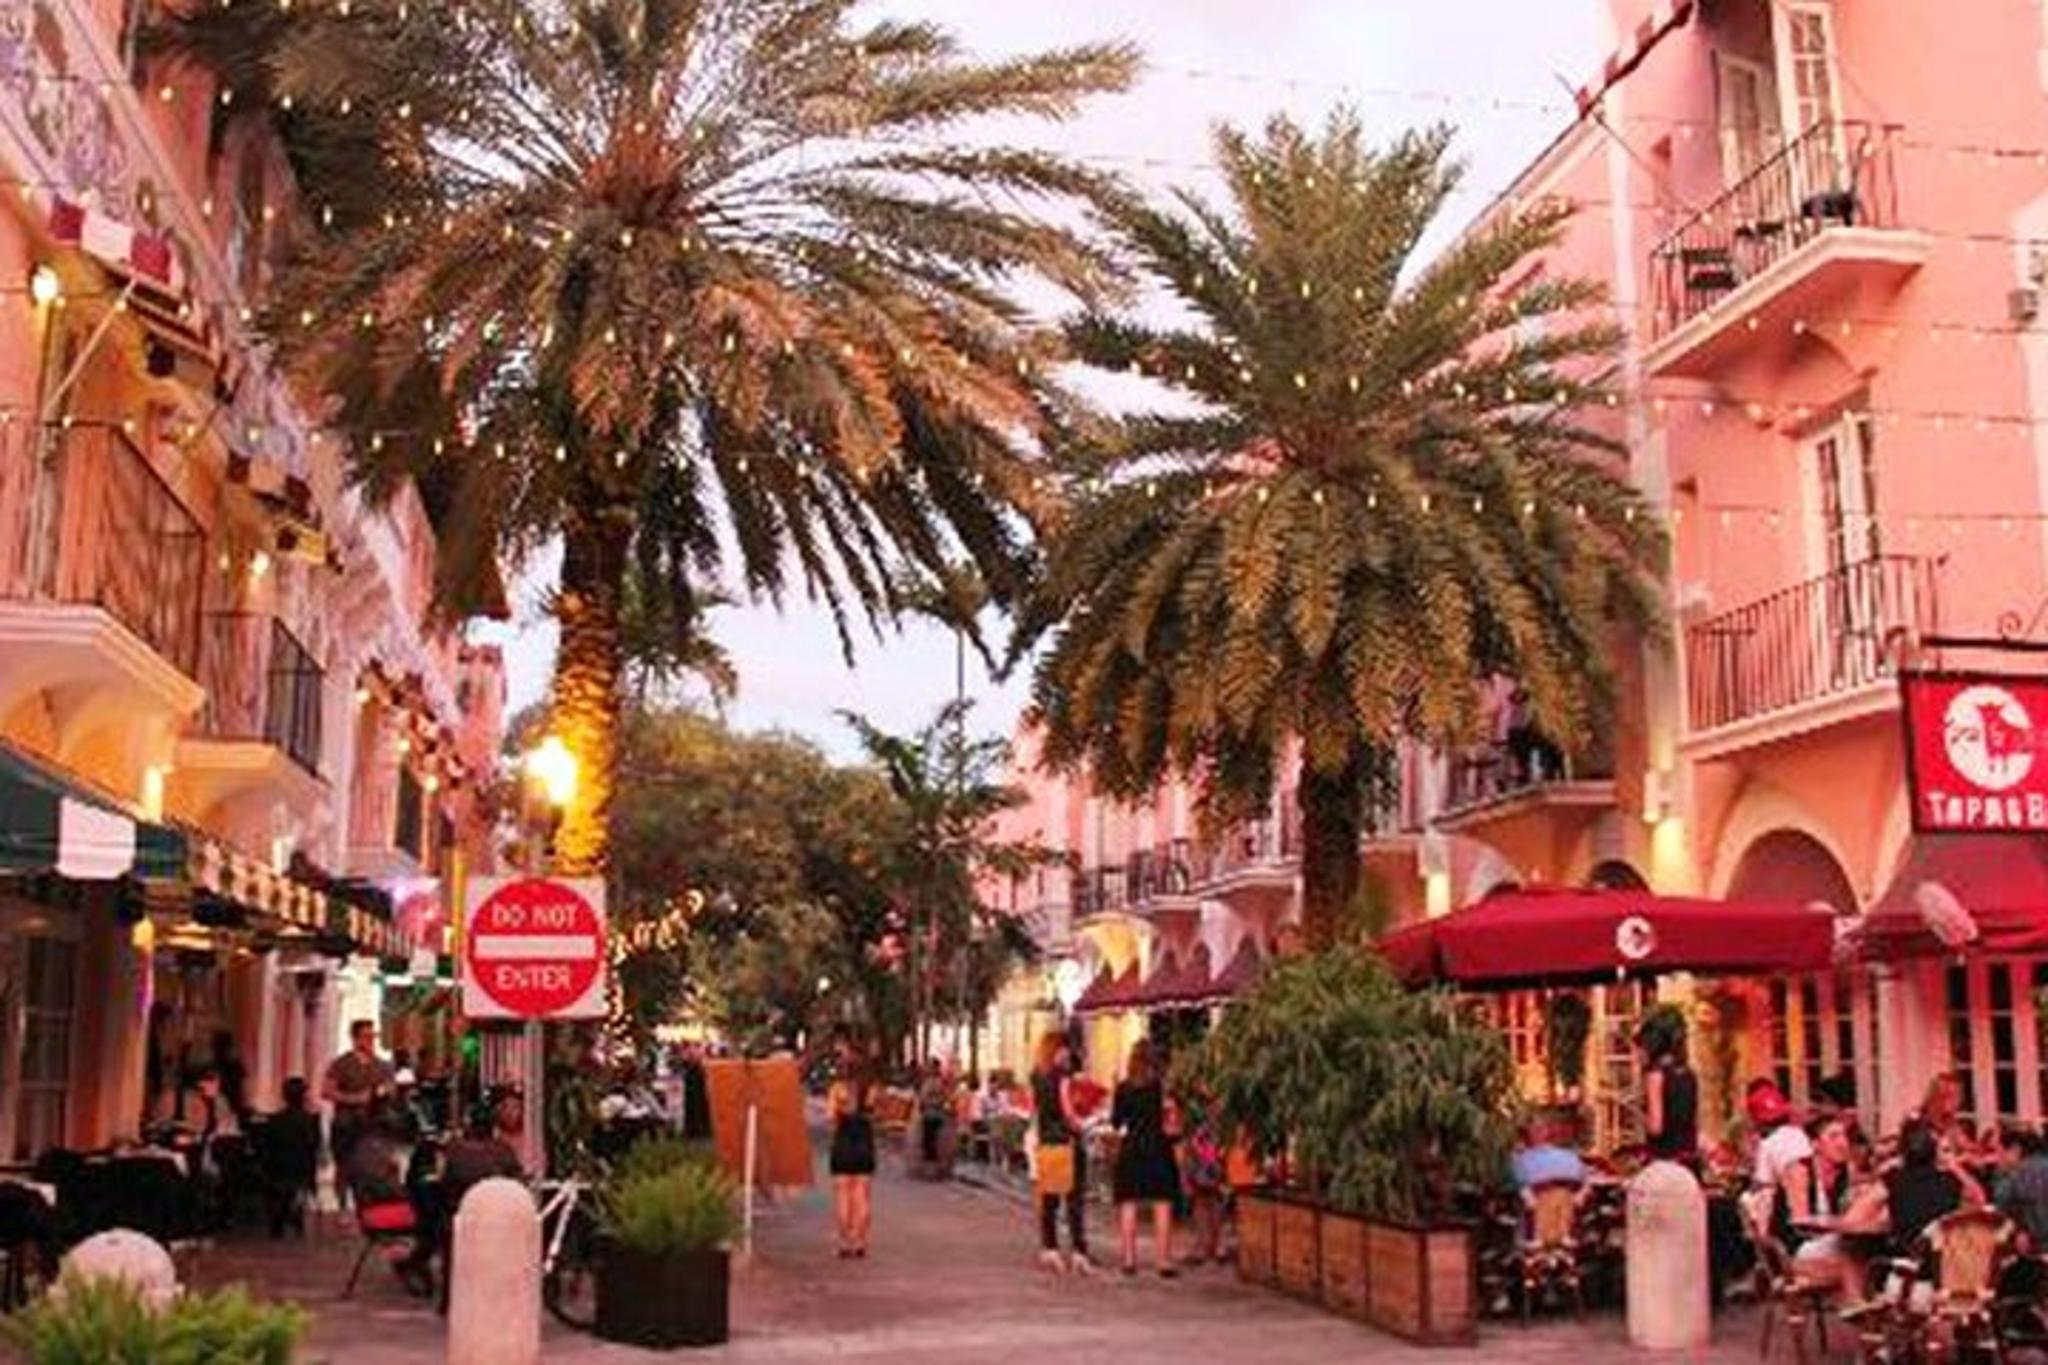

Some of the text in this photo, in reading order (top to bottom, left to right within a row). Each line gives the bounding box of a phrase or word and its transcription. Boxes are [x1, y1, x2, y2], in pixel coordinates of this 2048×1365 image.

[492, 903, 577, 928] DO NOT
[497, 965, 572, 991] ENTER
